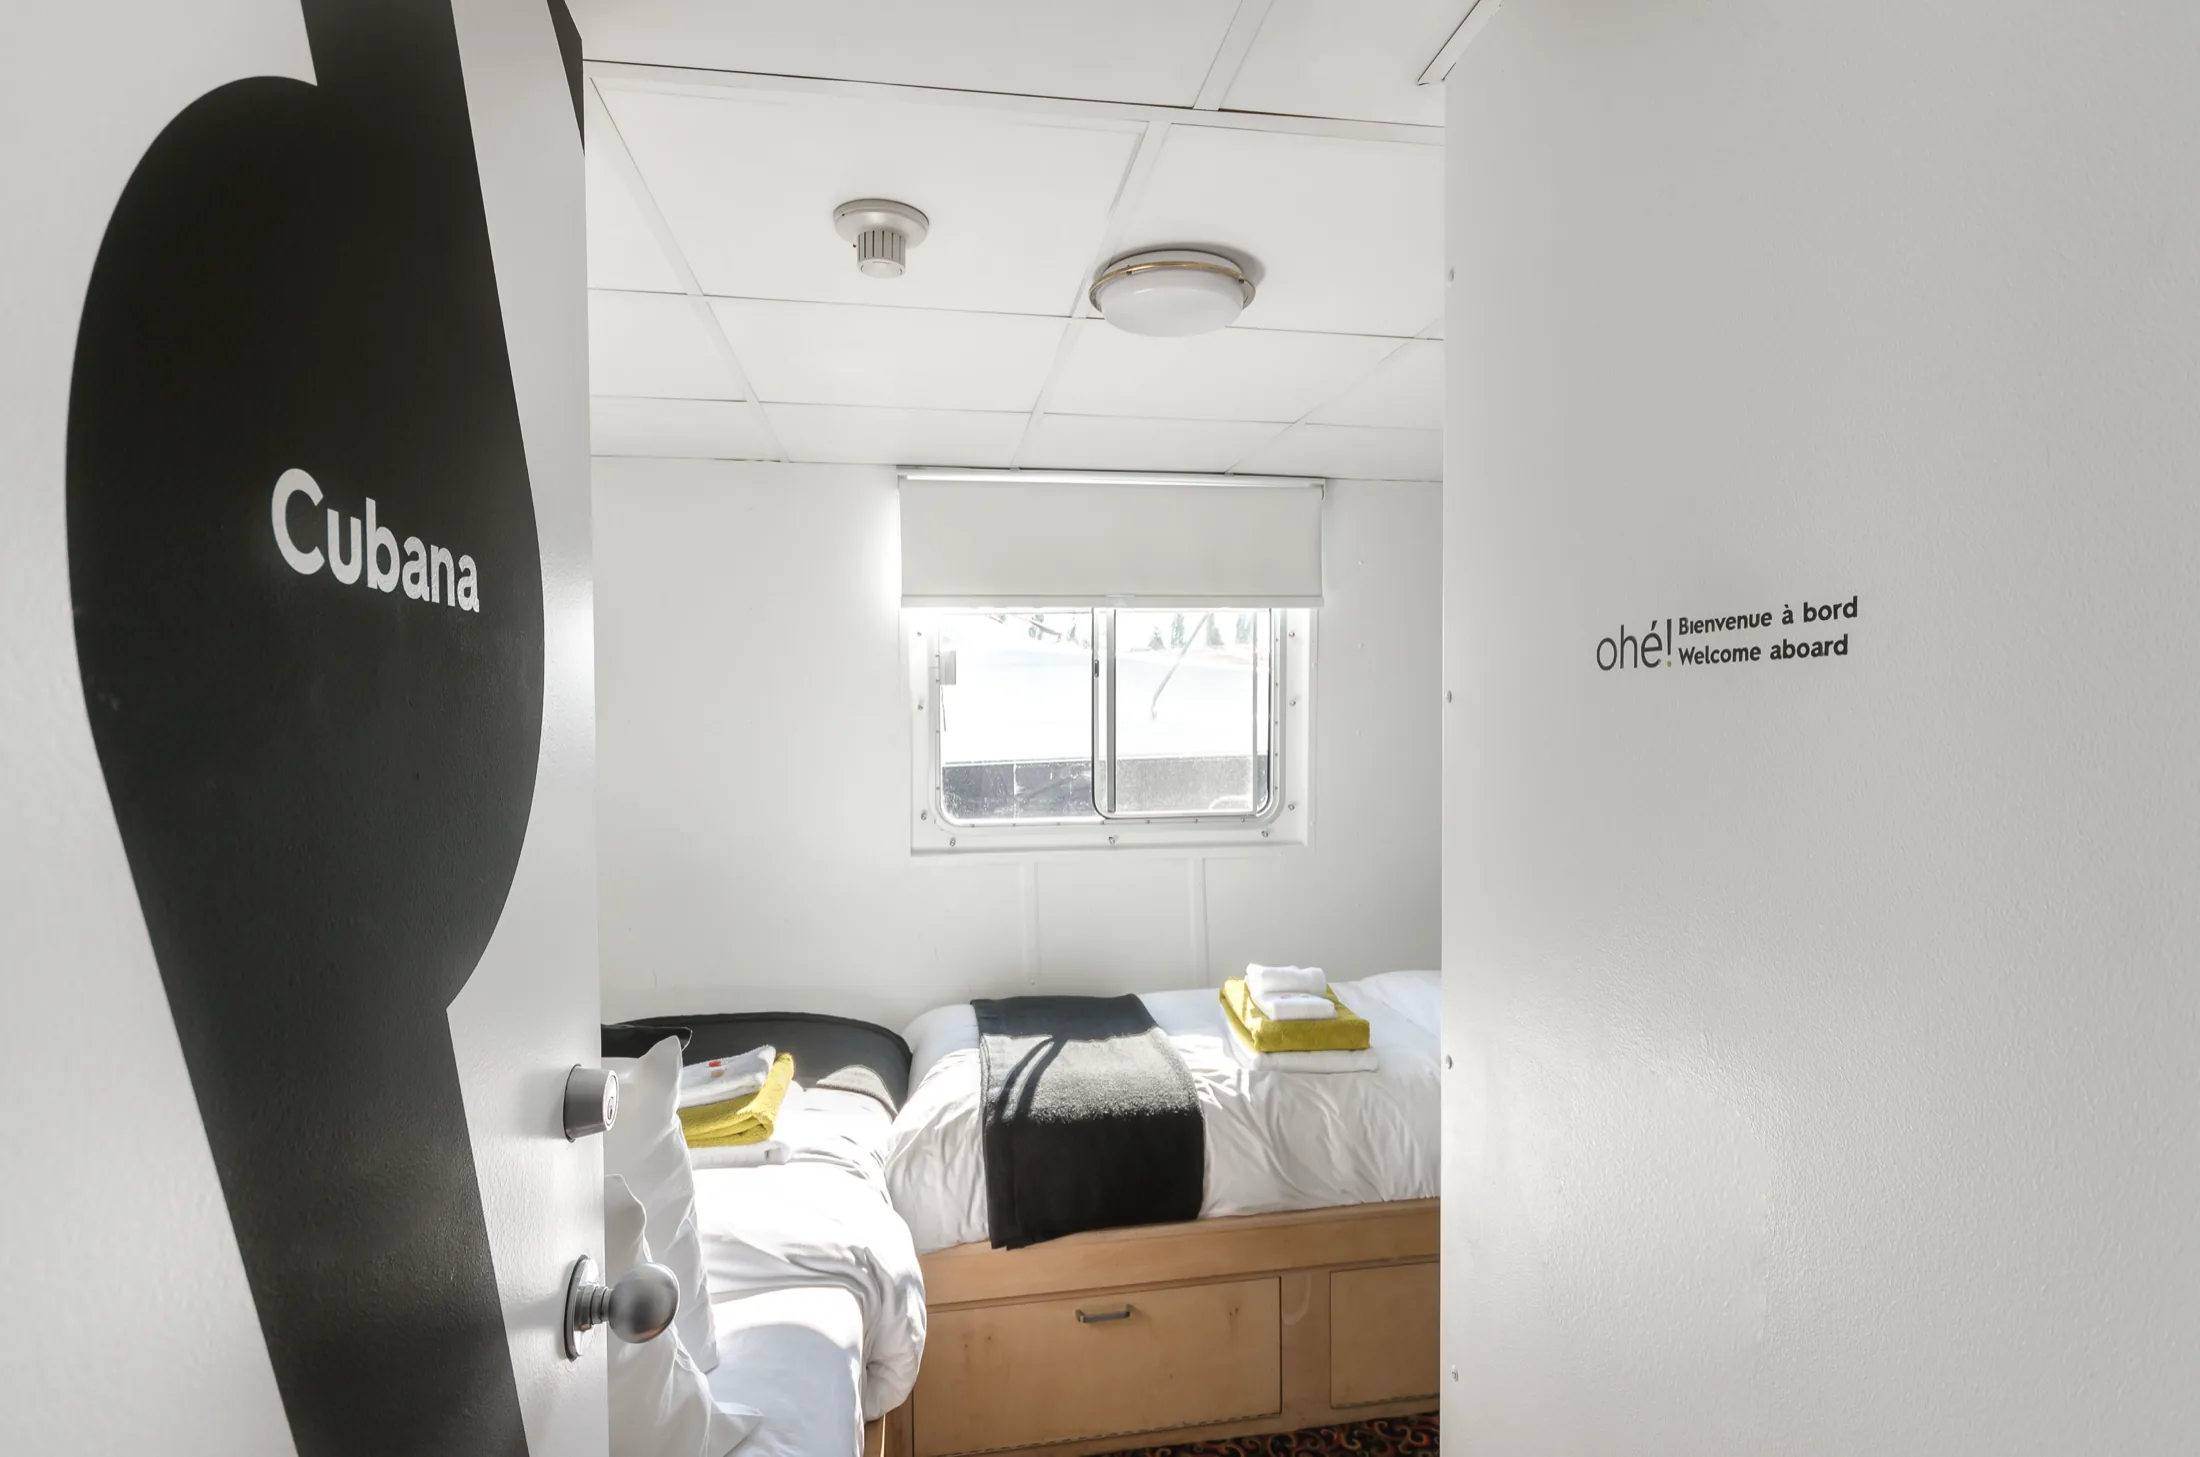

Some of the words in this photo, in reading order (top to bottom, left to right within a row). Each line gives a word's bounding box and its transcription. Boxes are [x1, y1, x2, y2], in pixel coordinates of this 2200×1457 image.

[271, 467, 480, 613] Cubana
[1678, 612, 1773, 636] Bienvenue
[1781, 604, 1794, 626] à
[1803, 596, 1858, 623] bord
[1596, 618, 1672, 671] ohé!
[1678, 645, 1762, 666] Welcome
[1769, 633, 1849, 661] aboard
